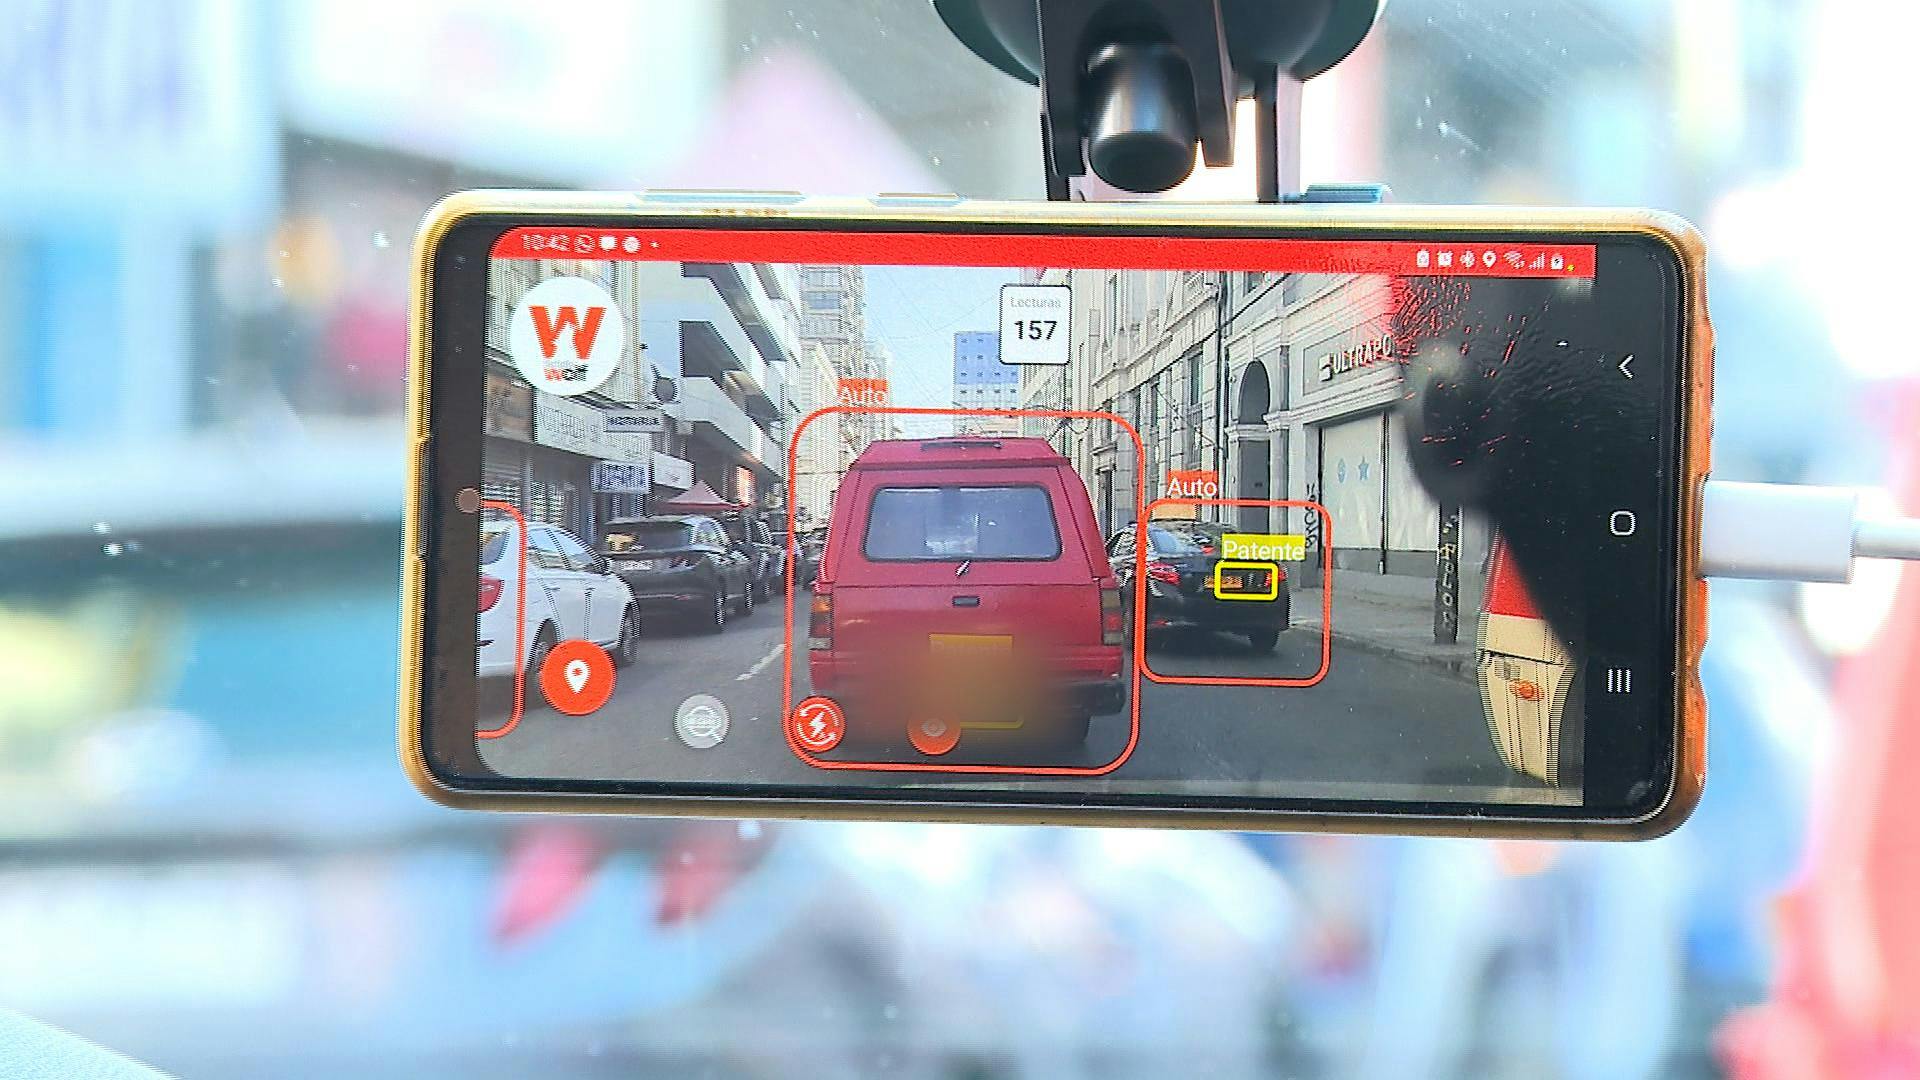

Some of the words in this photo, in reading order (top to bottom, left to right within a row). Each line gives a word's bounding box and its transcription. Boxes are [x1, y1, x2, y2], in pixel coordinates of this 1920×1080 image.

[521, 234, 570, 251] 10:42
[1010, 296, 1062, 309] Lecturas
[1014, 320, 1058, 341] 157
[1333, 334, 1394, 375] ULTRAPO
[544, 364, 588, 381] wolf
[838, 388, 888, 405] Auto
[607, 416, 660, 426] NOTARIA
[596, 463, 647, 491] NOTARIA
[1167, 478, 1218, 497] Auto
[1222, 540, 1306, 561] Patente
